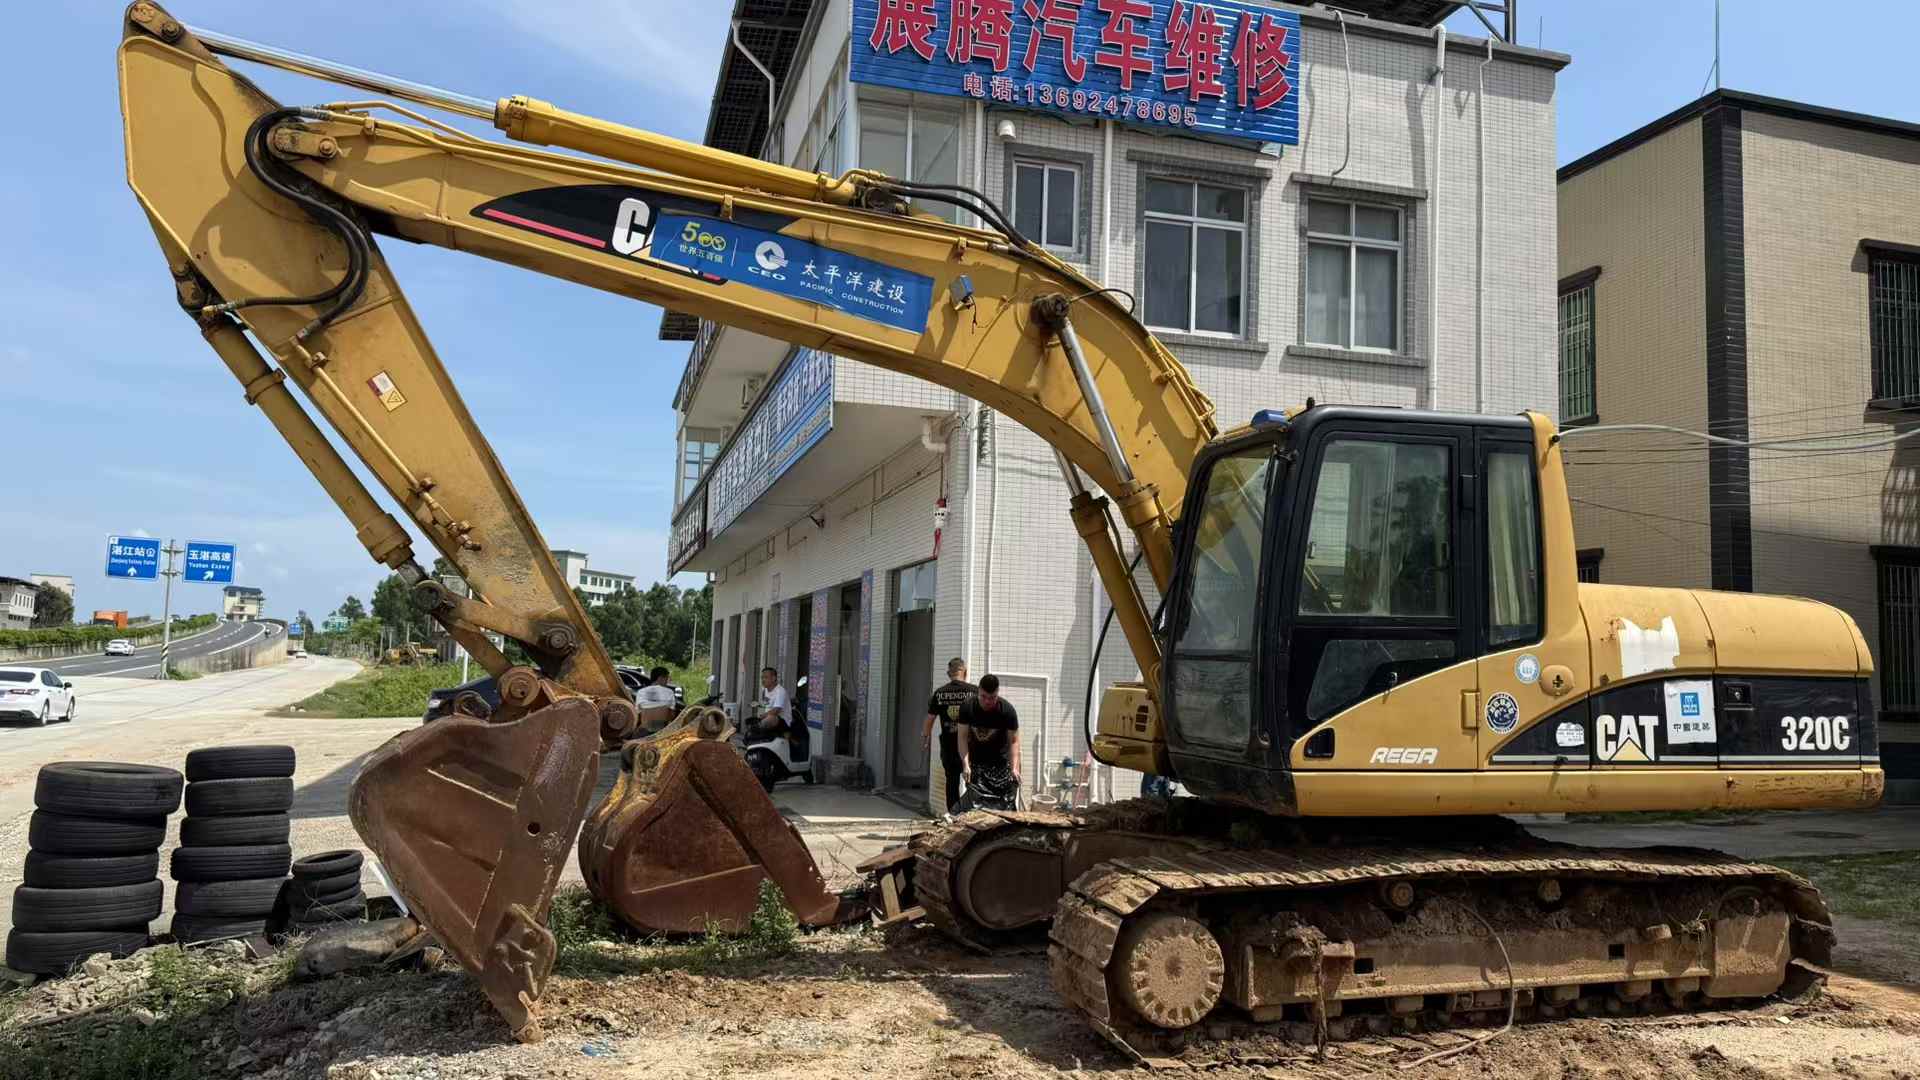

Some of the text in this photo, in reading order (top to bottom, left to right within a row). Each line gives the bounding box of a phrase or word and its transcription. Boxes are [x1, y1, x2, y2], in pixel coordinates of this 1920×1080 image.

[869, 0, 1292, 110] 展腾汽车维修
[800, 281, 905, 314] PACIFIC CONSTRUCTION
[801, 259, 906, 304] 太平洋建设
[1596, 714, 1658, 761] CAT
[1780, 716, 1850, 750] 320C
[1369, 747, 1439, 764] REGA
